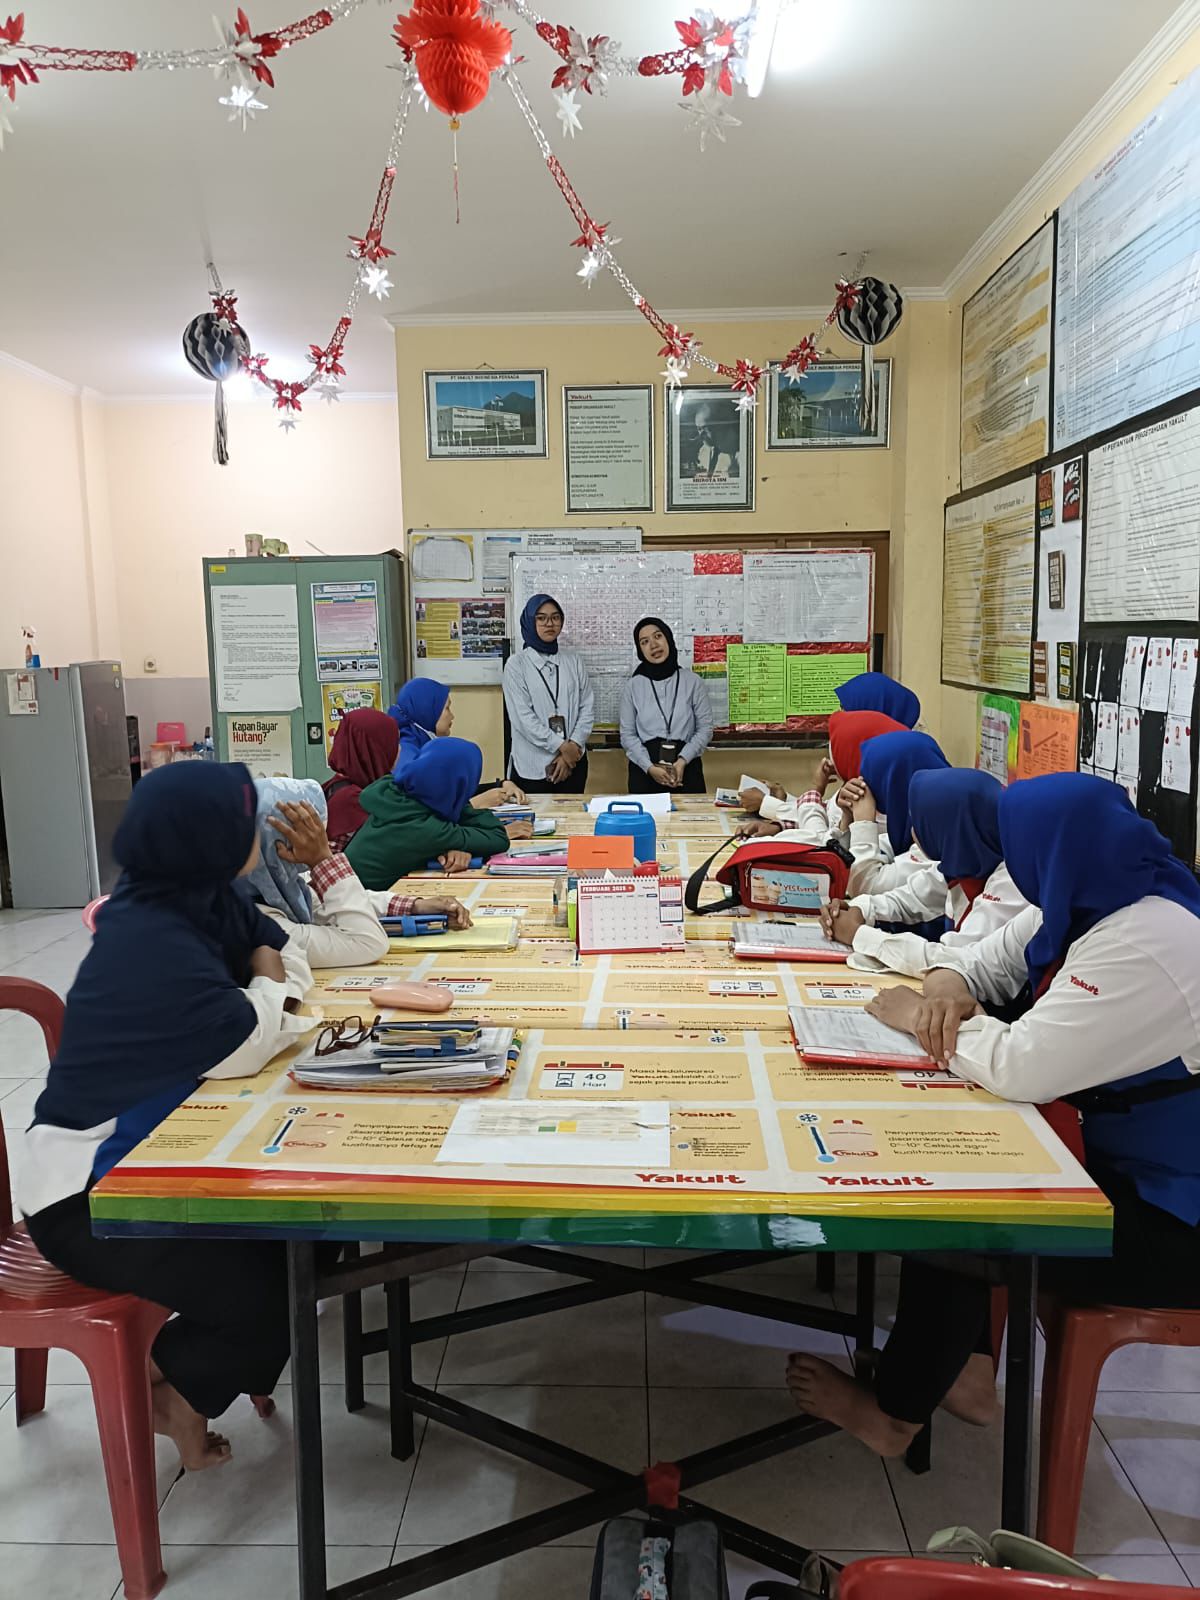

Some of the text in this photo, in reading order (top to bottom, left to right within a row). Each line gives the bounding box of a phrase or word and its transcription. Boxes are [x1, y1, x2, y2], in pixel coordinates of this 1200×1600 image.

[1135, 422, 1168, 440] PENGETAHUAN
[232, 721, 278, 733] Kapan Bayar
[232, 732, 267, 744] Hutang?
[1070, 974, 1099, 996] Yakult
[636, 1173, 746, 1184] Yakult
[818, 1176, 934, 1185] Yakult
